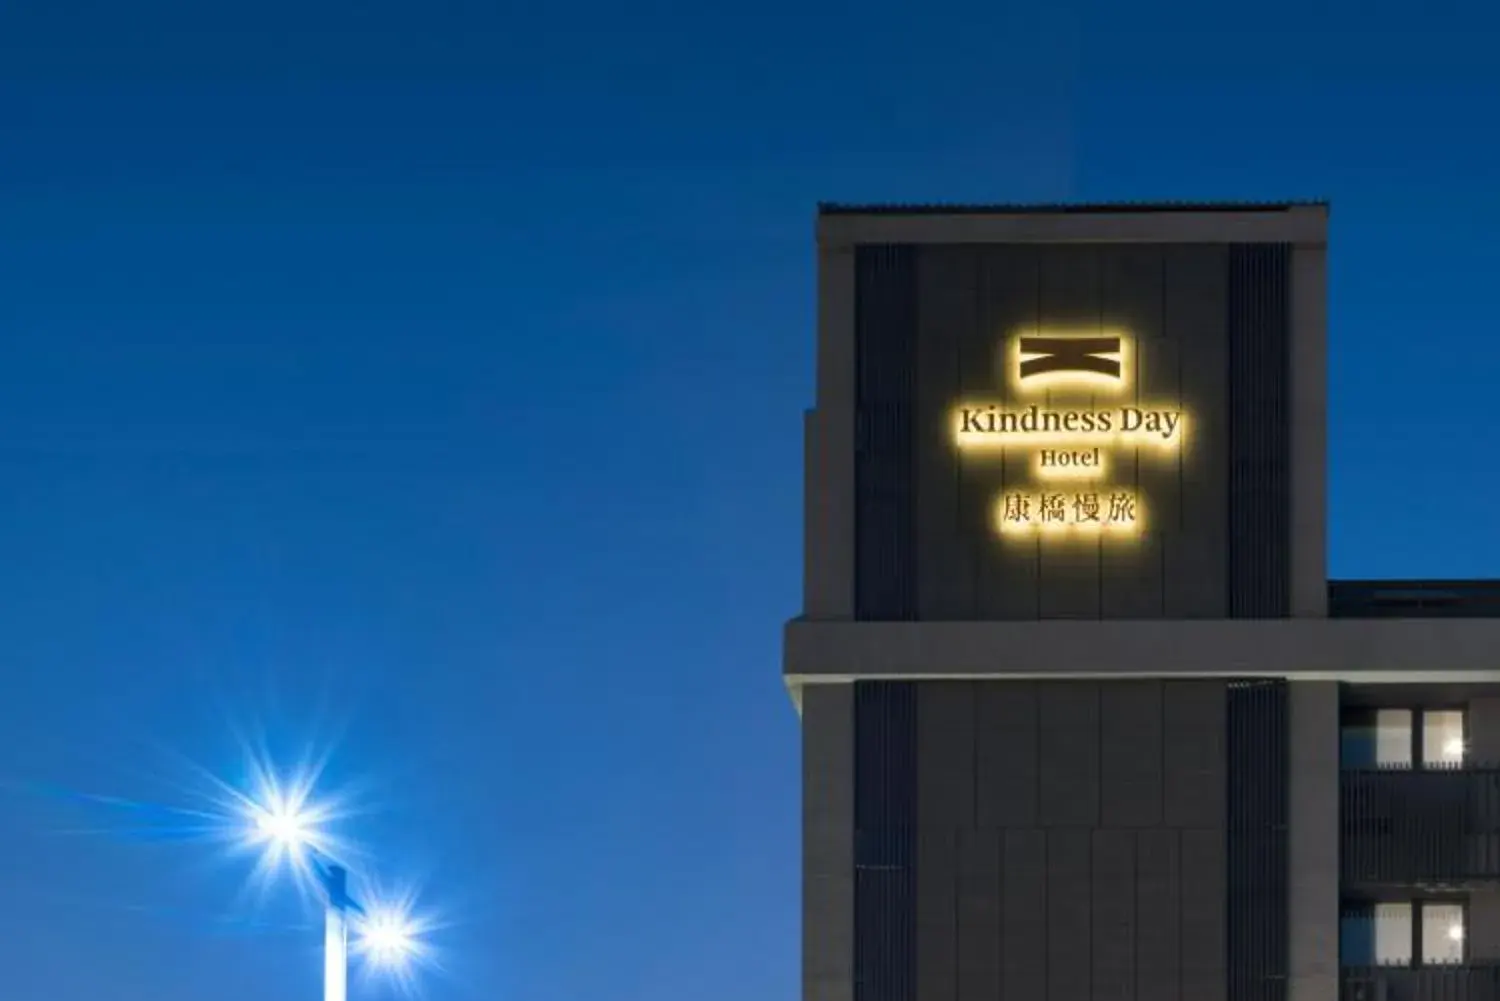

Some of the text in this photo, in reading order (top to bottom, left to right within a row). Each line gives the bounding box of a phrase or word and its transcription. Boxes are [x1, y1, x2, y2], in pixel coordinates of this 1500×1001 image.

[960, 405, 1180, 438] Kindness Day
[1040, 448, 1099, 467] Hotel
[1003, 493, 1136, 523] 康橋慢旅
